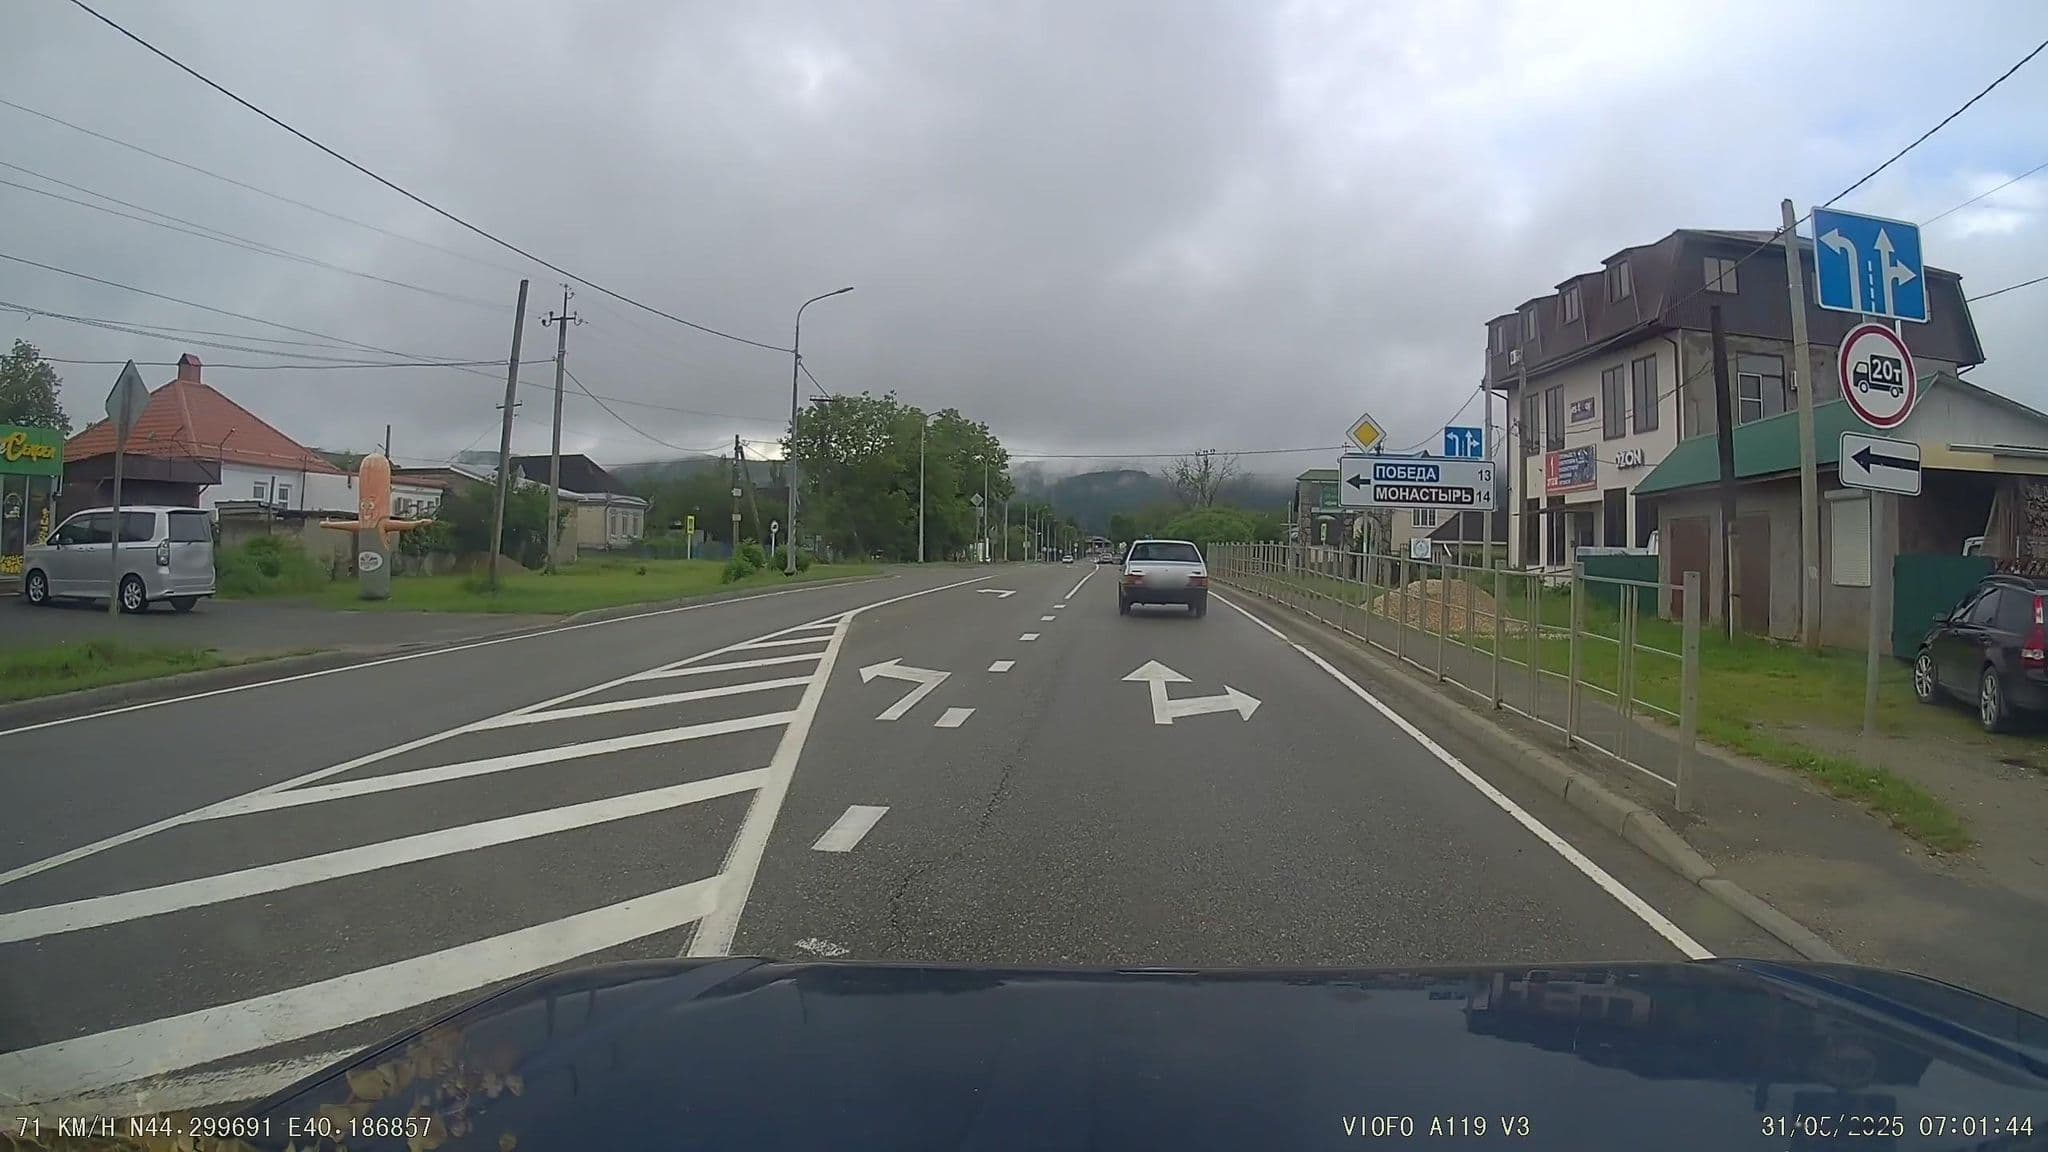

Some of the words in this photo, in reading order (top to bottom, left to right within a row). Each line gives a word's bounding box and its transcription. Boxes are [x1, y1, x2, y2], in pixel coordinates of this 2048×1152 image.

[1615, 448, 1641, 468] OZON
[1375, 465, 1437, 481] ПОБЕДА
[1478, 469, 1491, 482] 13
[1375, 487, 1472, 503] МОНАСТЫРЬ
[1476, 490, 1491, 503] 14
